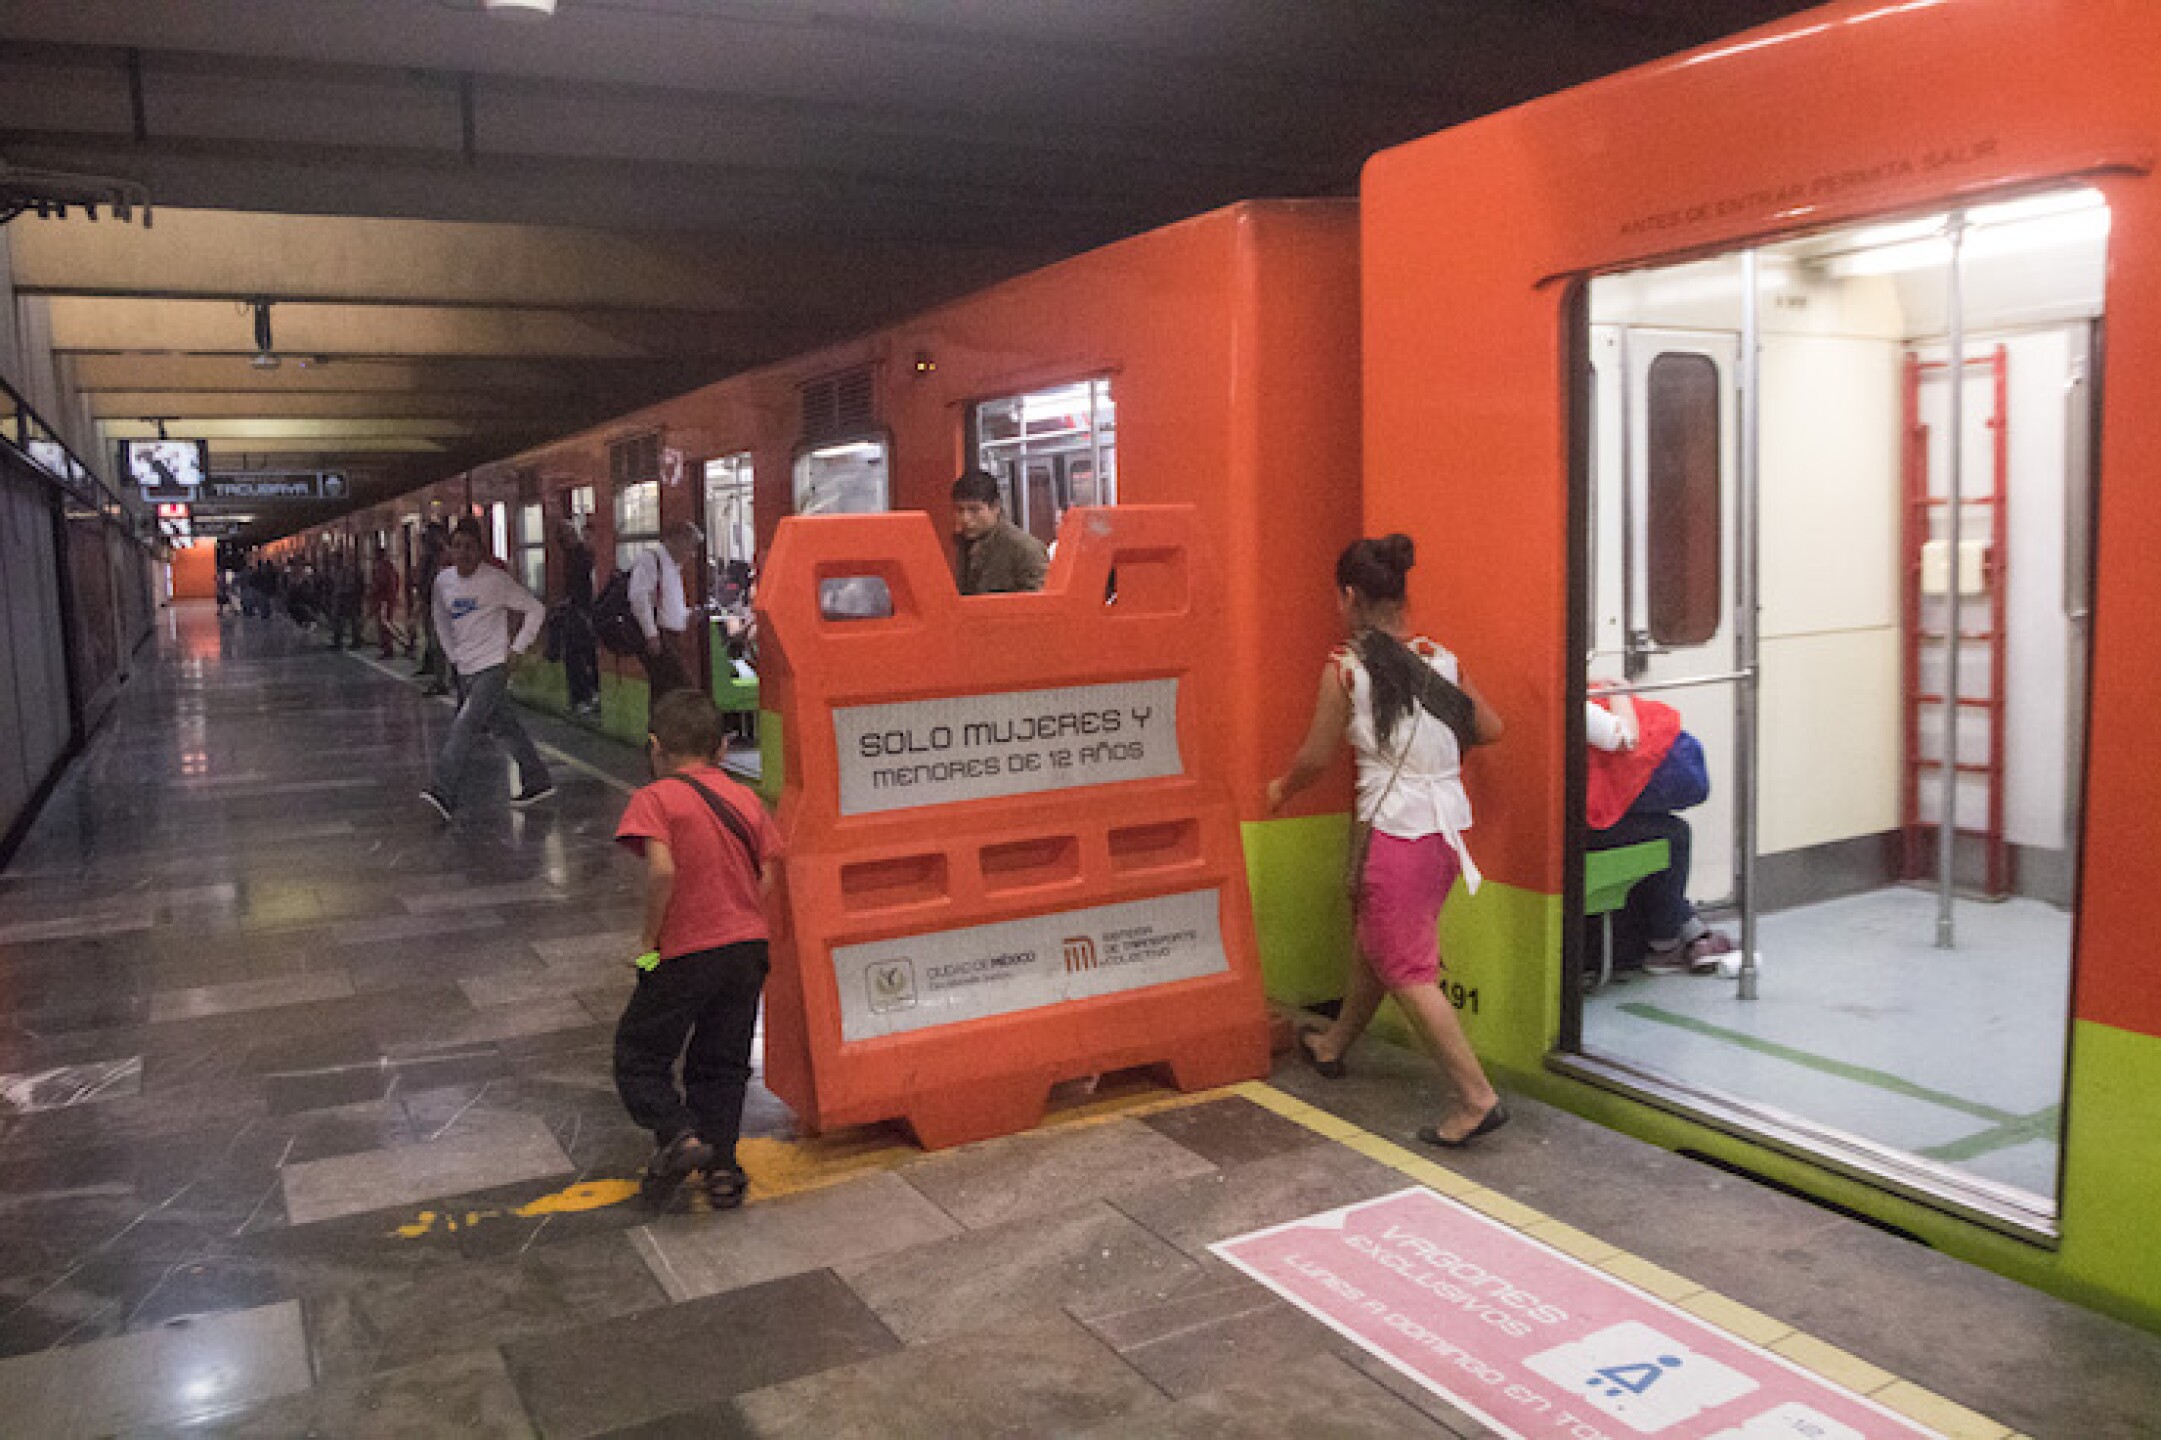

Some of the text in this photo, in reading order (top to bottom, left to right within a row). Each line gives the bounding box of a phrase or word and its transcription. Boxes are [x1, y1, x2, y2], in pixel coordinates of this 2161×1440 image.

[859, 706, 1152, 758] SOLO MUJERES Y
[872, 741, 1145, 789] MENORES DE 12 AÑOS
[1440, 980, 1479, 1015] 91
[1344, 1234, 1532, 1337] EXCLUSIVOS
[1381, 1225, 1569, 1324] VAGONES
[1282, 1253, 1366, 1300] LUNES
[1384, 1313, 1505, 1385] DOMINGO
[1504, 1383, 1552, 1412] EN
